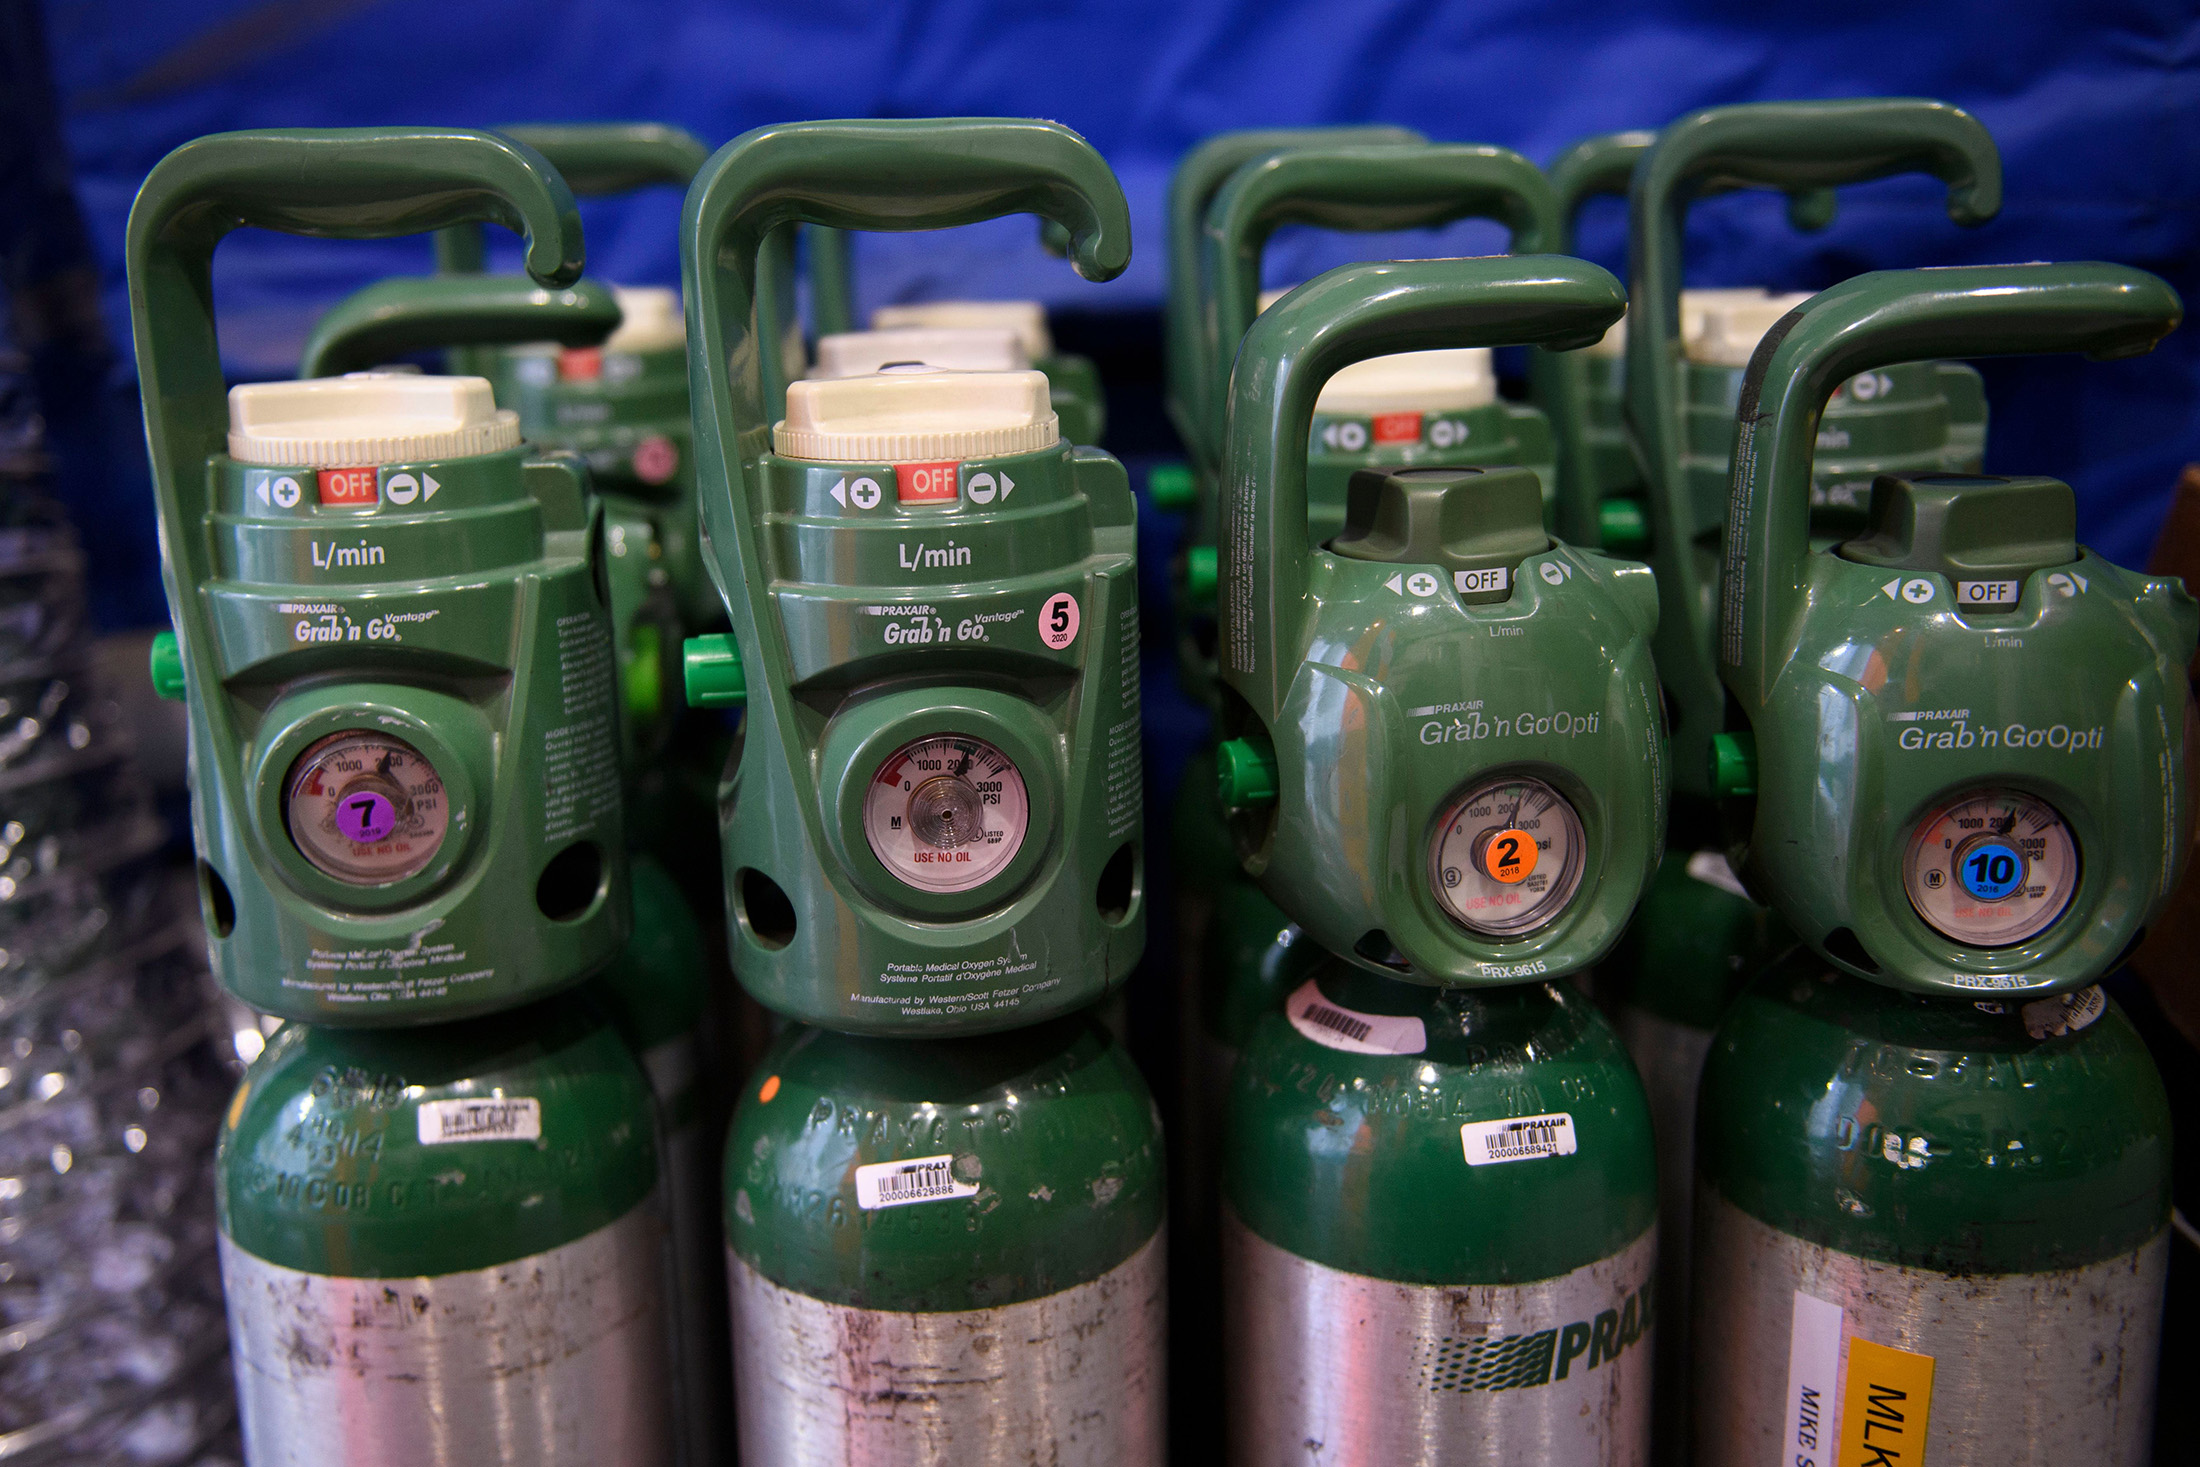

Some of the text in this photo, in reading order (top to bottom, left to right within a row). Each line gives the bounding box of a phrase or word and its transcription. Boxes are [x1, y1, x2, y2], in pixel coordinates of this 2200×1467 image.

[330, 473, 371, 497] OFF
[913, 468, 954, 493] OFF
[311, 539, 386, 570] L/min
[899, 540, 971, 572] L/min
[1464, 571, 1498, 591] OFF
[1969, 583, 2008, 601] OFF
[292, 604, 337, 614] PRAXAIR
[882, 605, 930, 616] PRAXAIR
[1051, 601, 1069, 632] 5
[295, 615, 343, 642] Grab
[367, 619, 396, 640] Go
[884, 617, 932, 644] Grab
[957, 619, 984, 641] Go
[975, 611, 1018, 624] Vantage
[1489, 625, 1524, 637] L/min
[1051, 633, 1067, 643] 2020
[1435, 700, 1484, 714] PRAXAIR
[1916, 709, 1970, 721] PRAXAIR
[1419, 712, 1490, 745] Grab
[1900, 720, 1975, 750] Grab
[336, 759, 363, 772] 1000
[375, 755, 403, 768] 200
[917, 760, 942, 771] 1000
[947, 759, 974, 771] 200
[328, 786, 336, 797] 0
[904, 781, 911, 792] 0
[976, 781, 1003, 793] 3000
[416, 798, 437, 811] PSI
[983, 794, 1001, 805] PSI
[351, 800, 376, 829] 7
[1469, 806, 1491, 818] 1000
[891, 816, 902, 828] M
[1518, 819, 1541, 830] 3000
[1958, 818, 1984, 829] 1000
[1989, 817, 2016, 829] 200
[1456, 825, 1462, 835] 0
[1945, 838, 1951, 849] 0
[2019, 837, 2046, 849] 3000
[914, 852, 972, 863] USE NO OIL
[1497, 838, 1520, 868] 2
[2027, 850, 2044, 861] PSI
[1500, 866, 1520, 877] 2018
[1969, 853, 2014, 885] 10
[1929, 873, 1940, 885] M
[1977, 884, 1999, 893] 2016
[1466, 893, 1521, 910] USE NO OIL
[1955, 907, 1975, 918] USE
[1978, 907, 1993, 917] NO
[921, 973, 953, 983] Portatif
[1005, 961, 1038, 975] Medical
[925, 962, 960, 972] Medical
[961, 960, 995, 970] Oxygen
[1481, 960, 1548, 979] PRX-9615
[1953, 973, 2029, 989] PRX-9615
[914, 996, 925, 1006] by
[992, 987, 1020, 998] Fetzer
[946, 1005, 967, 1014] Ohio
[971, 1002, 990, 1011] USA
[994, 998, 1020, 1008] 44145
[1523, 1118, 1567, 1130] PRAXAIR
[1489, 1143, 1558, 1159] 200006589421
[880, 1185, 954, 1202] 200006629886
[1798, 1385, 1820, 1451] MIKE
[1860, 1383, 1907, 1467] MLK
